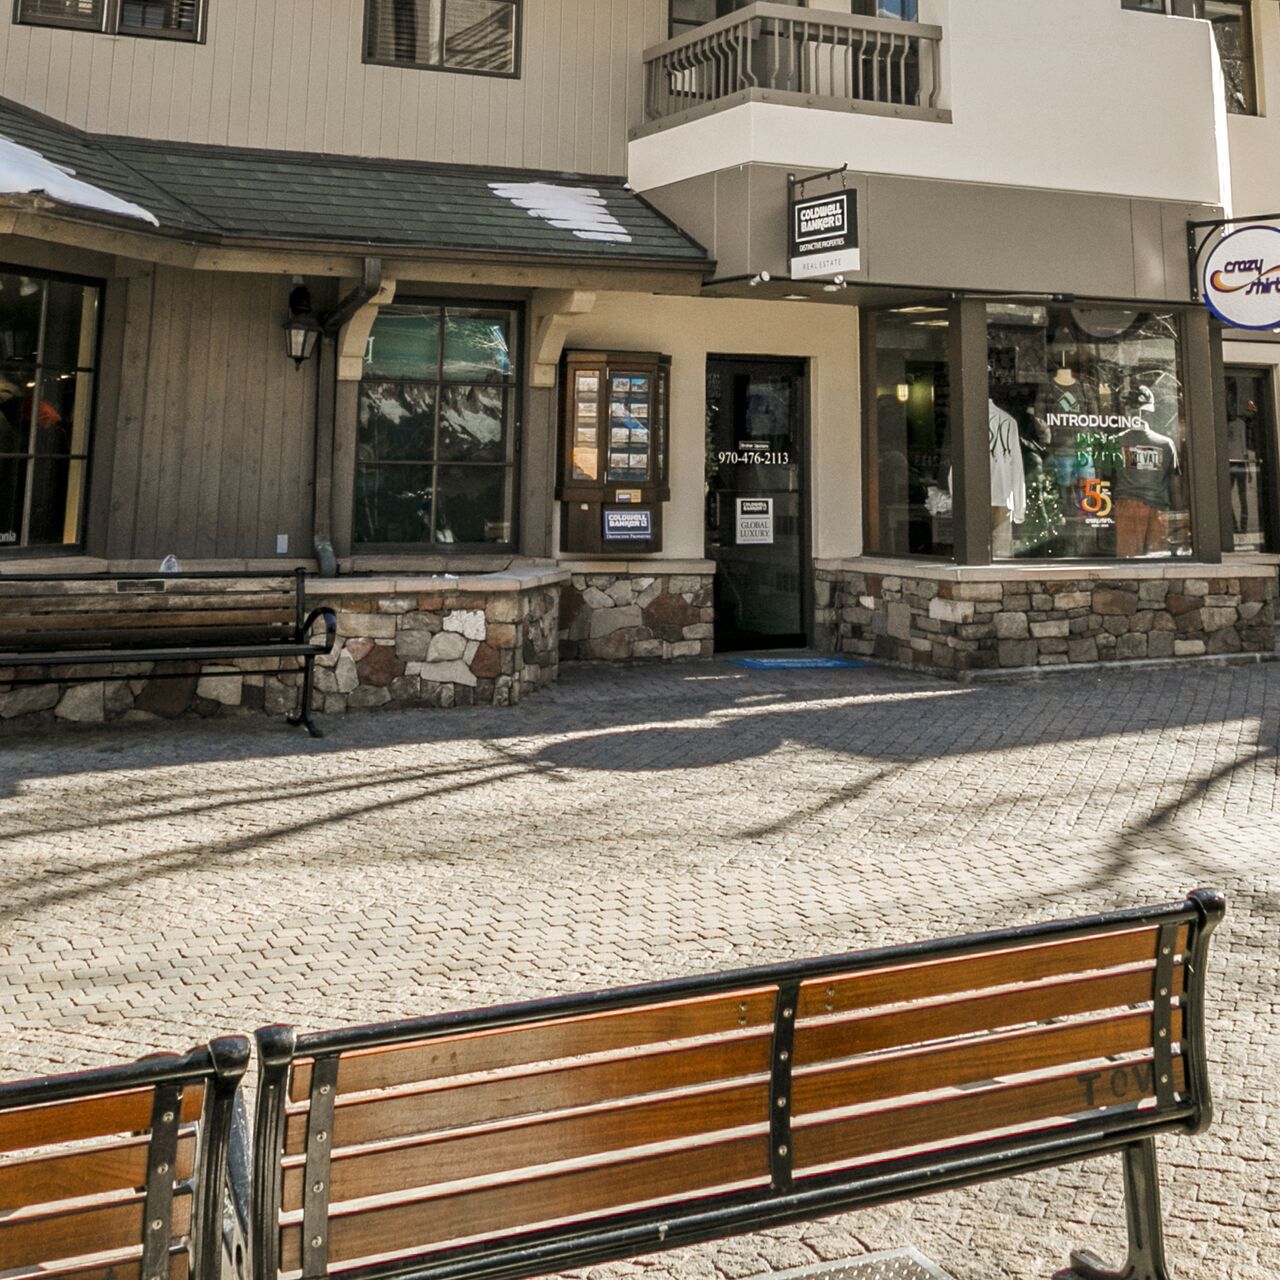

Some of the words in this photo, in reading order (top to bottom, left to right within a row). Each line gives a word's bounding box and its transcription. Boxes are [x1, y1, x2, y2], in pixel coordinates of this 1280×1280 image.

[803, 262, 818, 271] REAL
[819, 258, 842, 269] ESTATE
[1224, 258, 1263, 275] crazy
[1046, 413, 1141, 428] INTRODUCING
[718, 451, 789, 464] 970-476-2113
[741, 520, 768, 529] GLOBAL
[740, 529, 769, 538] LUXURY
[1076, 1062, 1152, 1105] TOV
